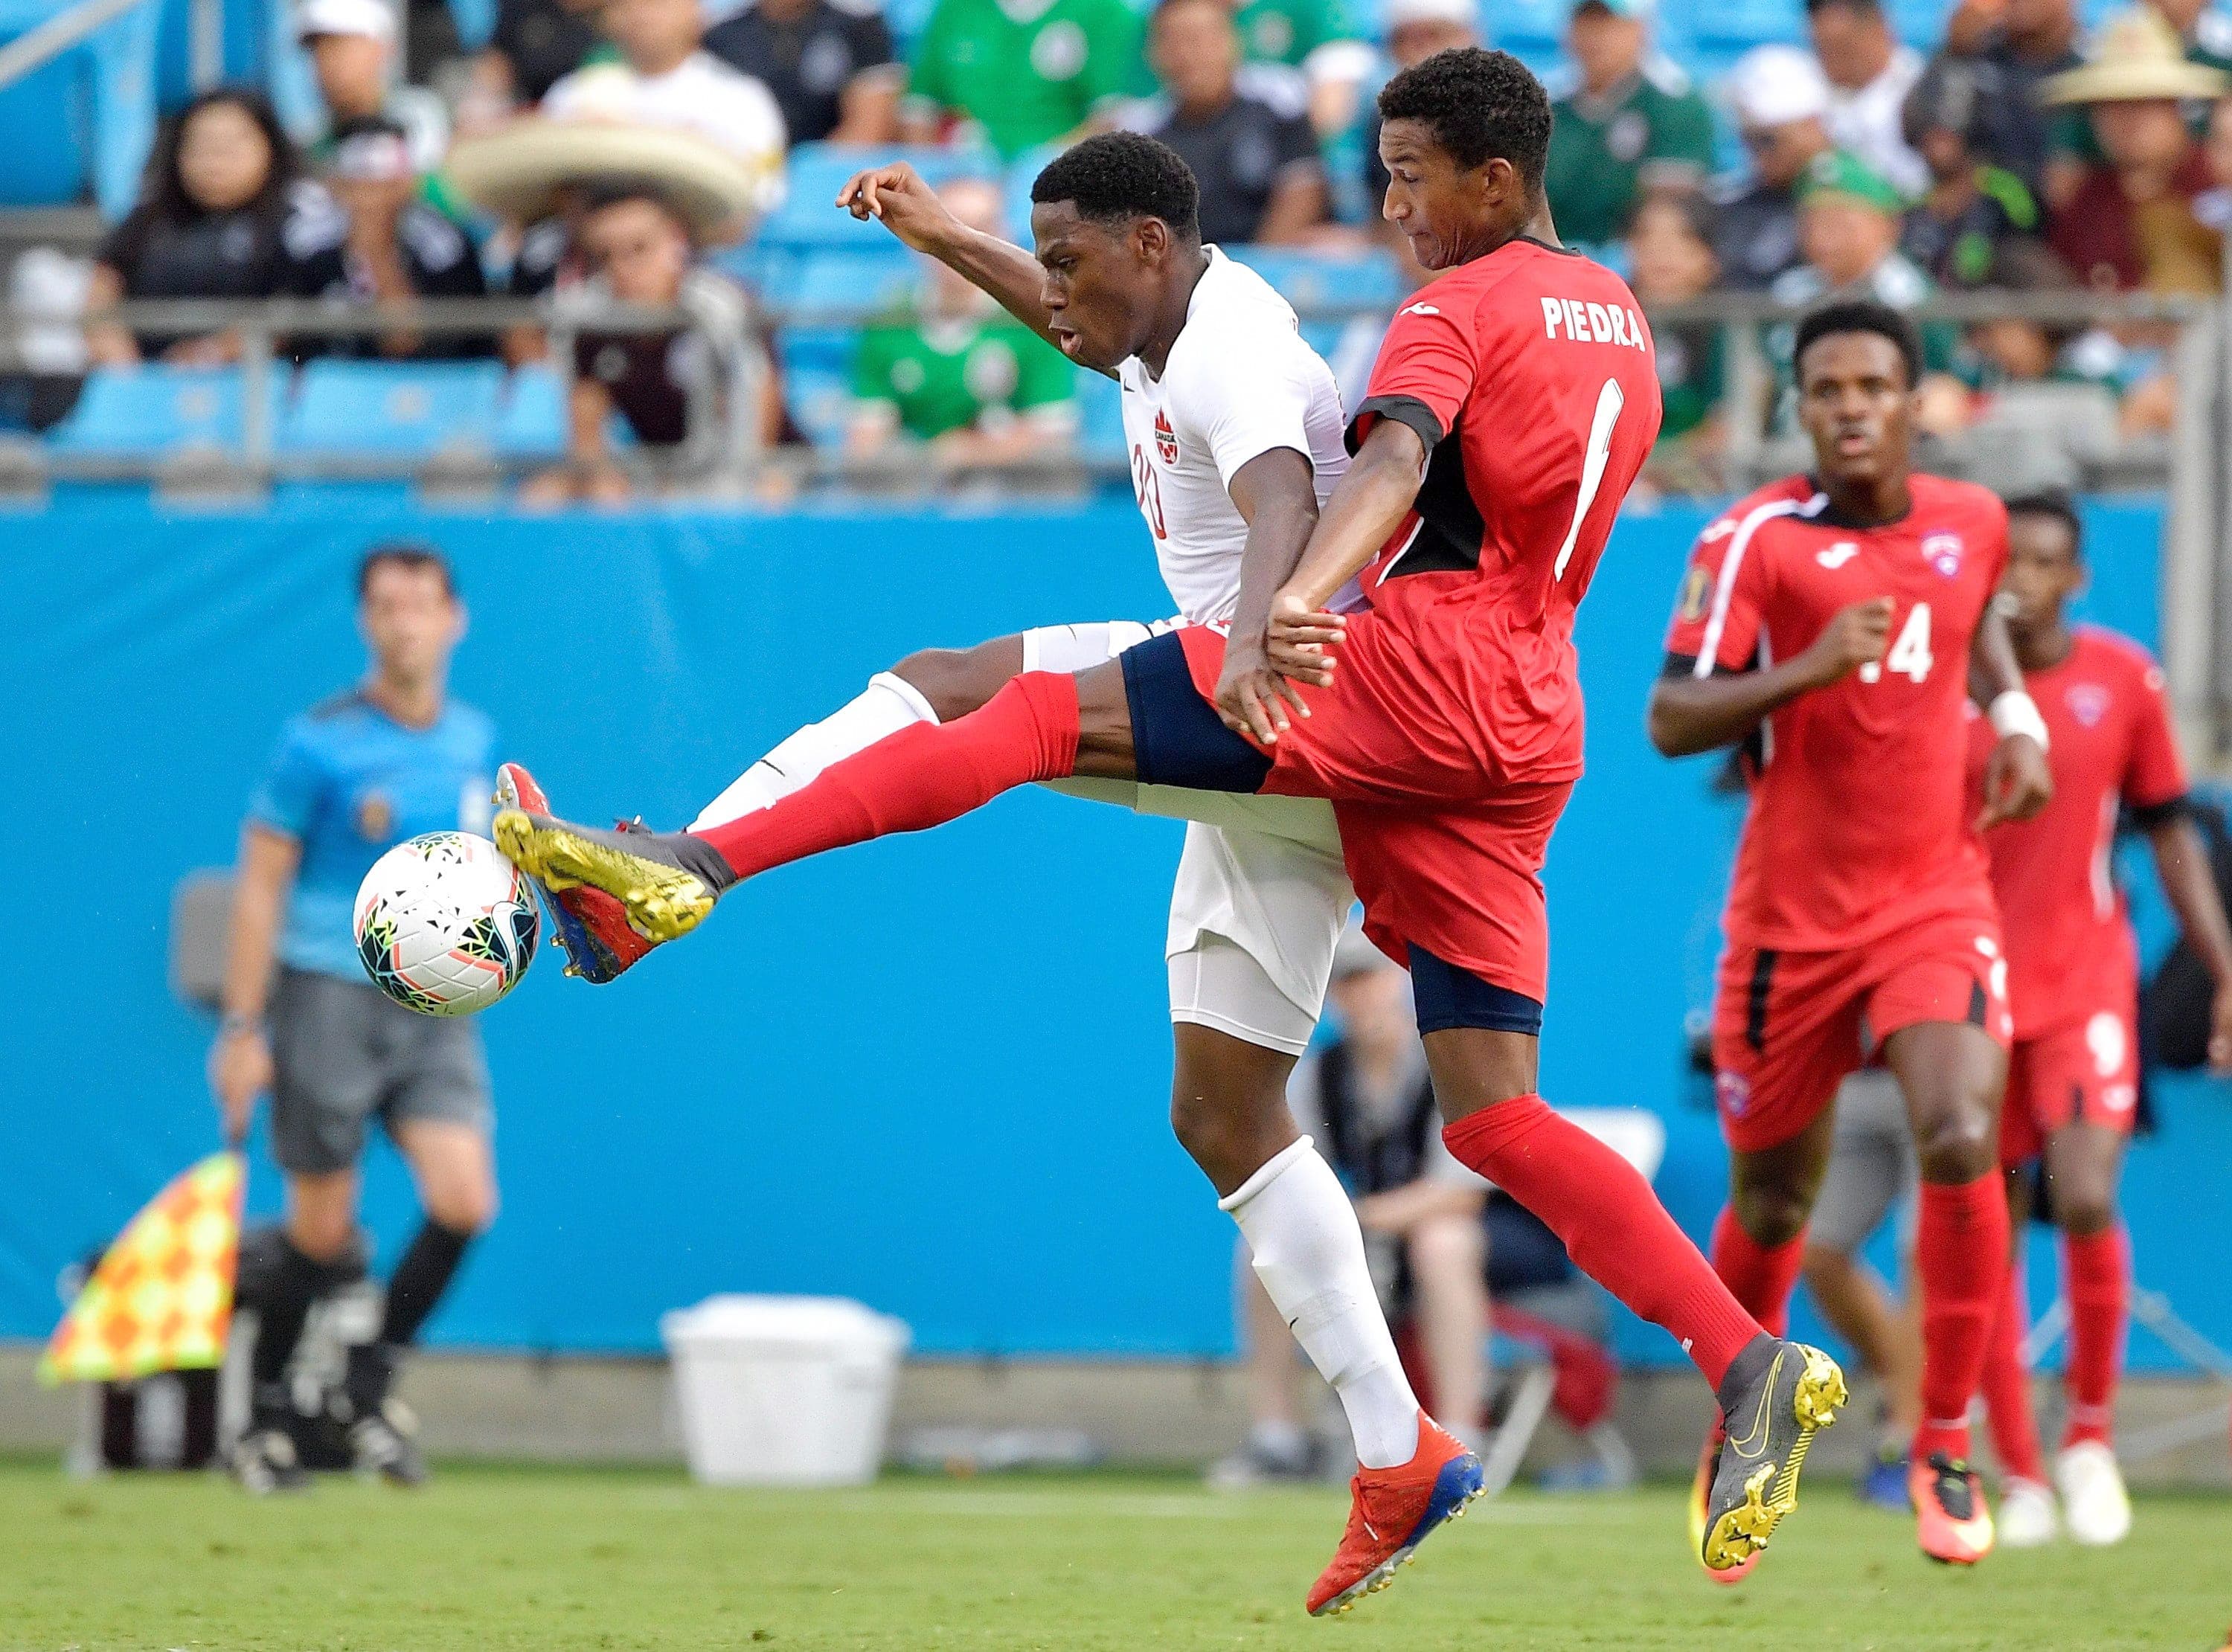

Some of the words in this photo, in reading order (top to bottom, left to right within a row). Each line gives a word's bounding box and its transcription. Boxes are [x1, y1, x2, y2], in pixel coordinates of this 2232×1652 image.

[1541, 297, 1646, 353] PIEDRA
[1155, 431, 1176, 443] CANADA
[1861, 602, 1933, 684] 4
